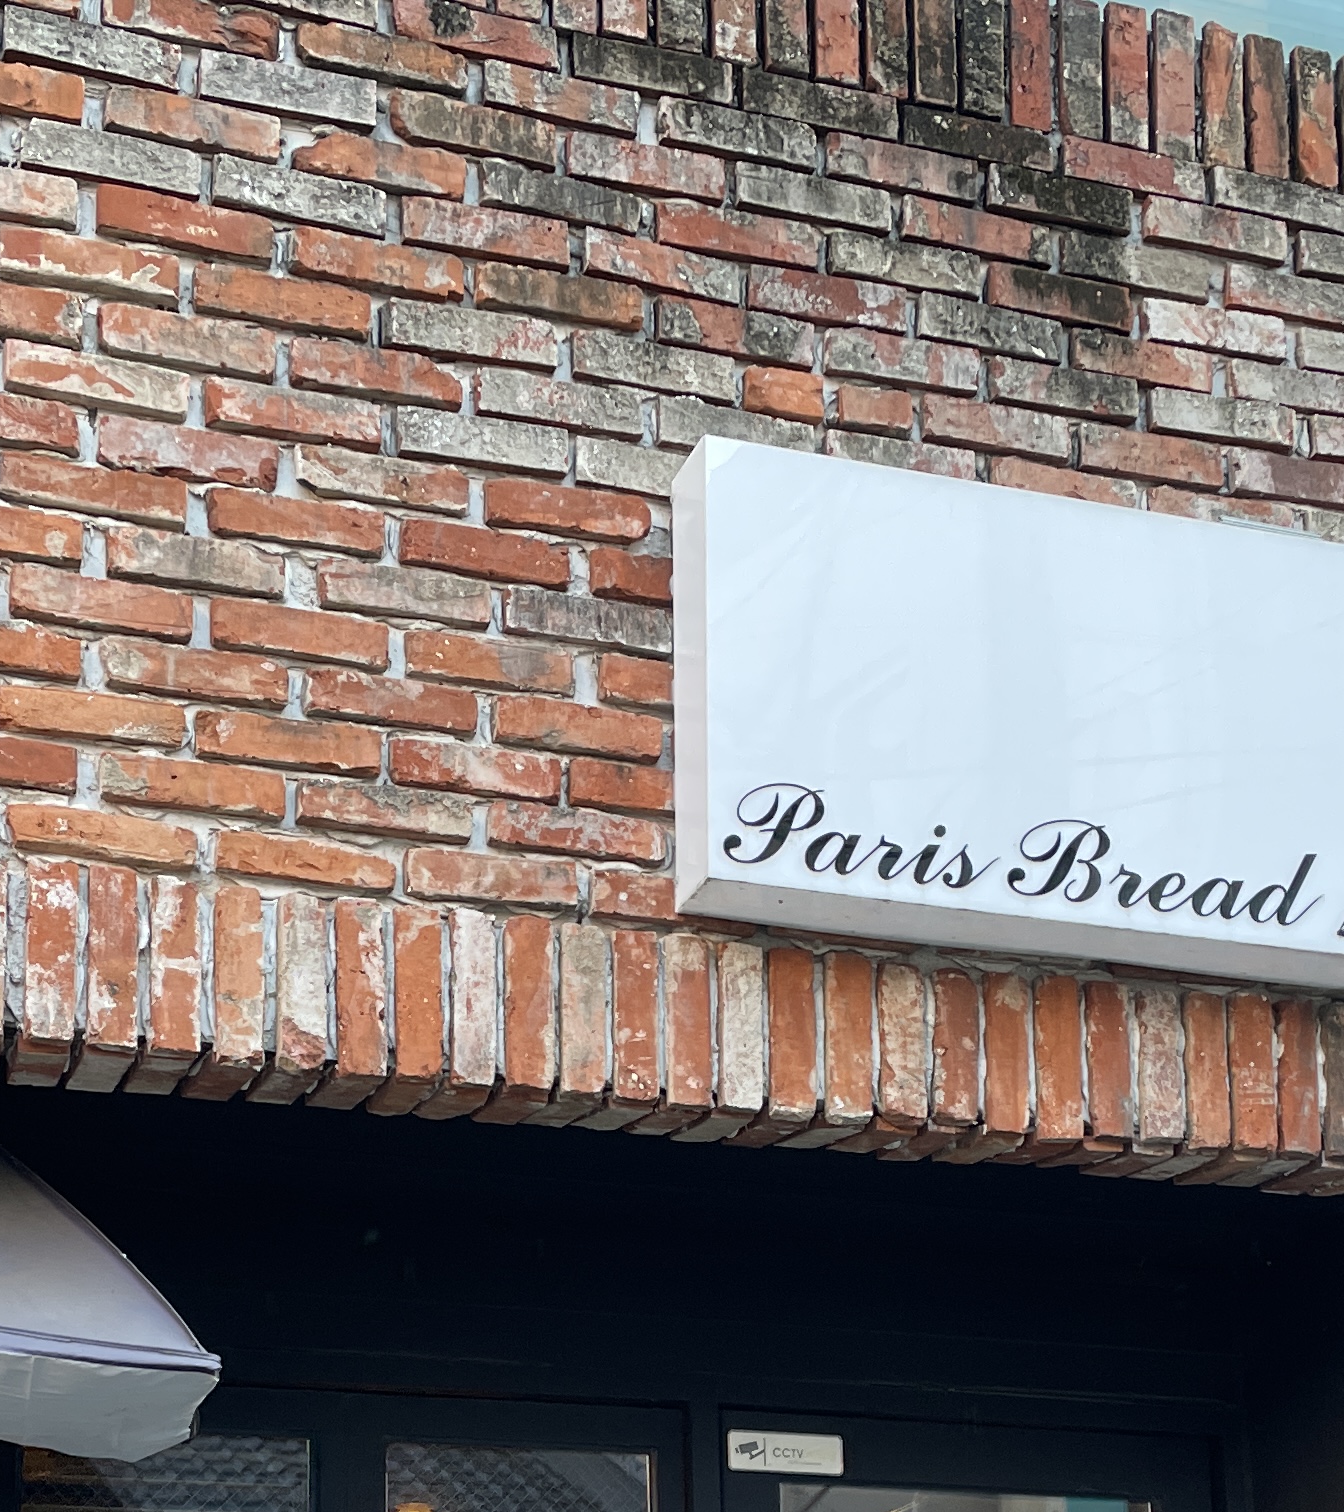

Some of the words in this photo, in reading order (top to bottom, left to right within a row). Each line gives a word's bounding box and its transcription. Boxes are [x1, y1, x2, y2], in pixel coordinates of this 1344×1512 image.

[723, 783, 998, 888] Paris
[1007, 819, 1324, 928] Bread
[772, 1447, 804, 1459] CCTV
